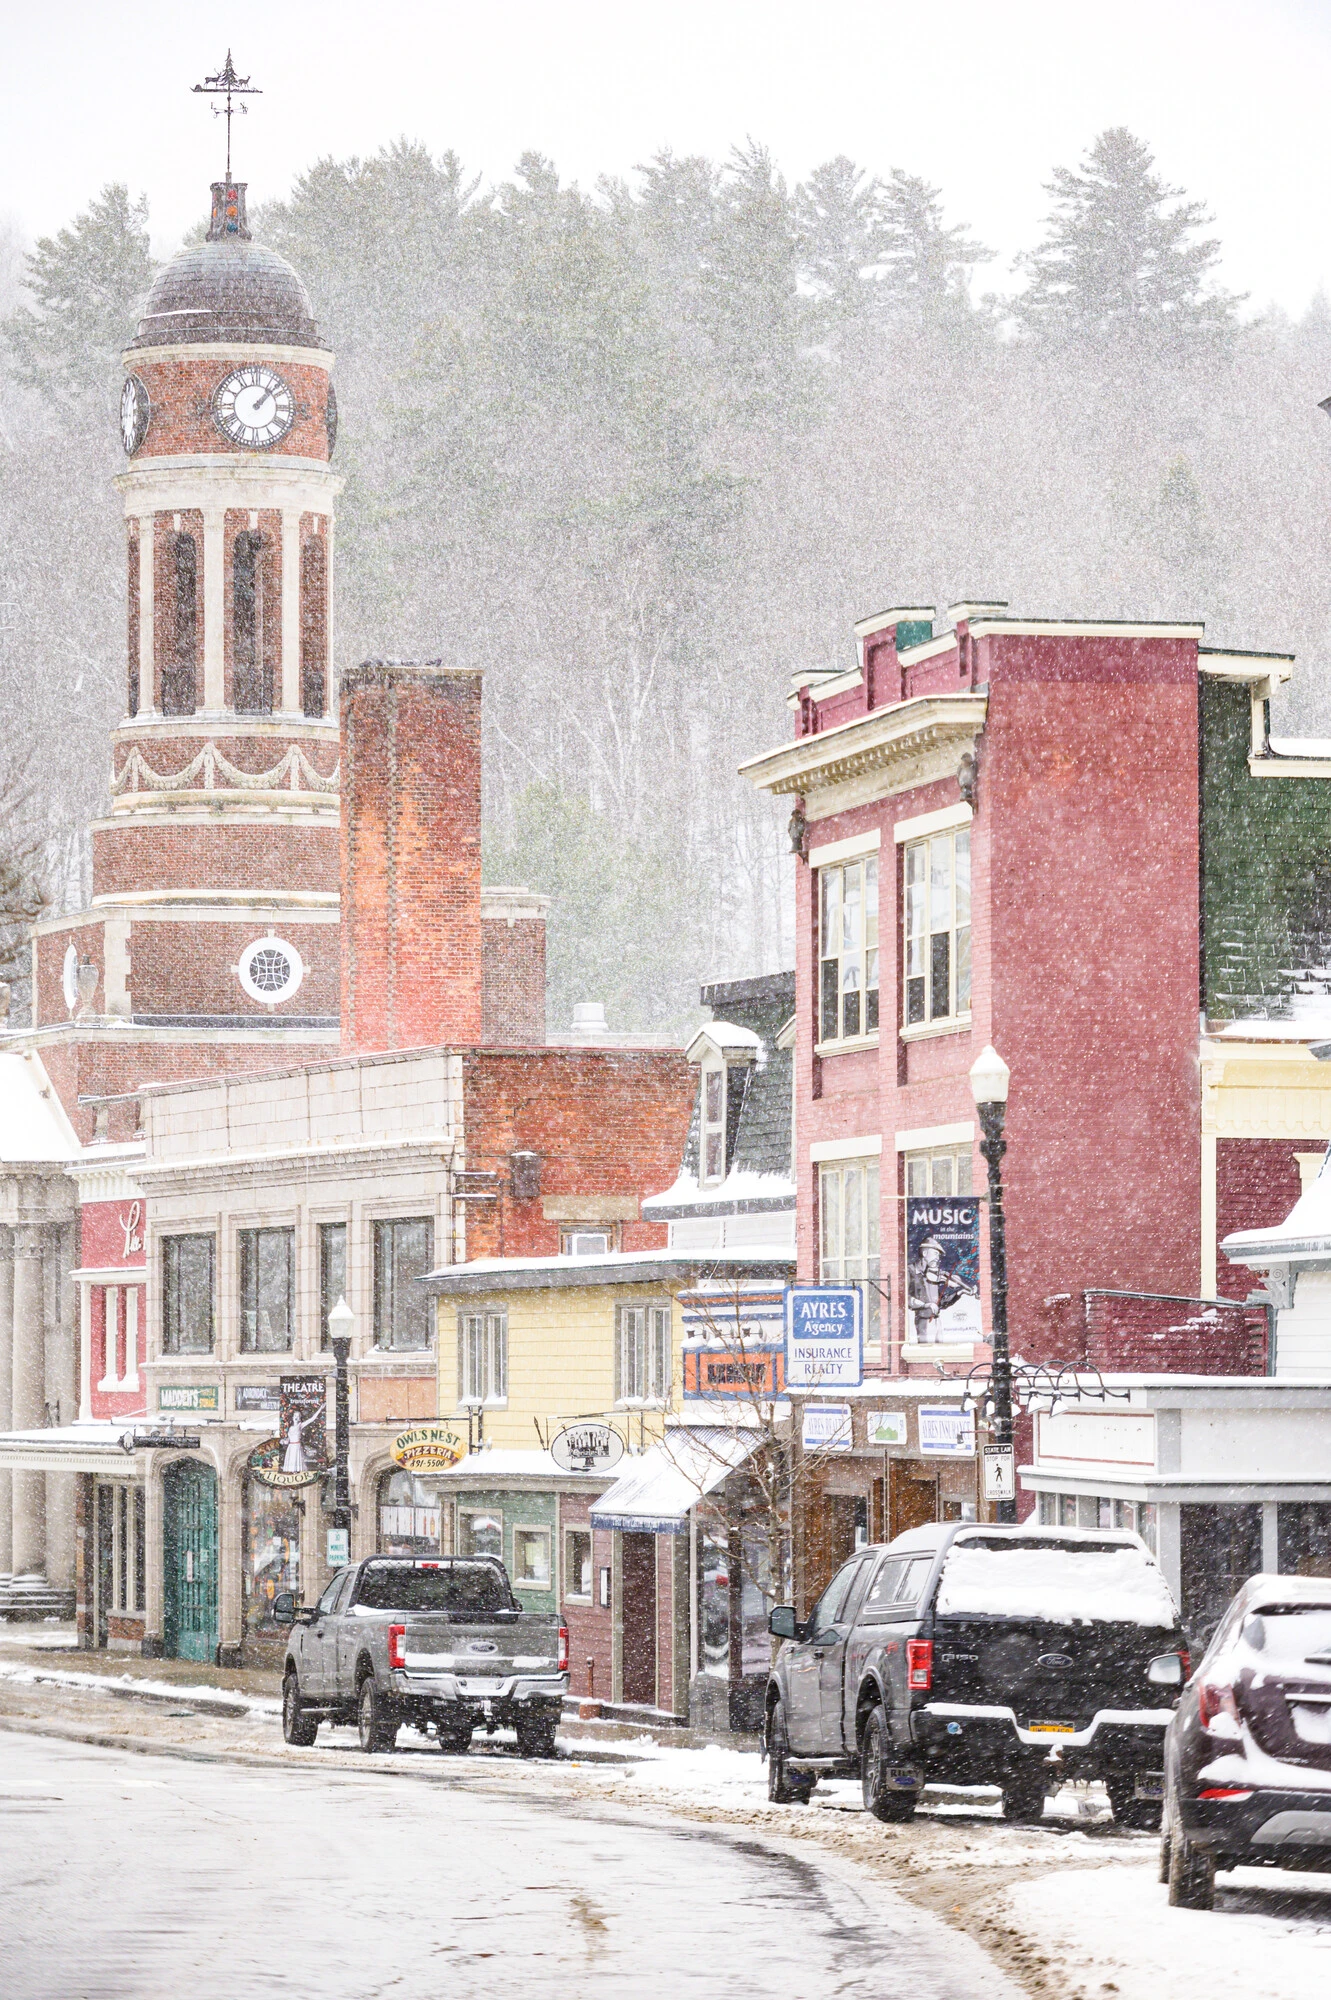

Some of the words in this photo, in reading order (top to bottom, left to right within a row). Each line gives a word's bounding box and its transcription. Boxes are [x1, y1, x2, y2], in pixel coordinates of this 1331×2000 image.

[912, 1209, 973, 1225] MUSIC
[933, 1232, 974, 1240] mountains
[801, 1302, 847, 1318] AYRES
[804, 1321, 843, 1336] Agency
[794, 1347, 852, 1359] INSURANCE
[804, 1363, 843, 1375] REALTY
[282, 1382, 325, 1393] THEATRE
[922, 1420, 938, 1439] AYRES
[396, 1429, 428, 1449] OWL'S
[430, 1429, 461, 1446] NEST
[405, 1446, 452, 1459] PIZZERIA
[266, 1471, 313, 1484] LIQUOR
[1046, 1656, 1066, 1666] Ford
